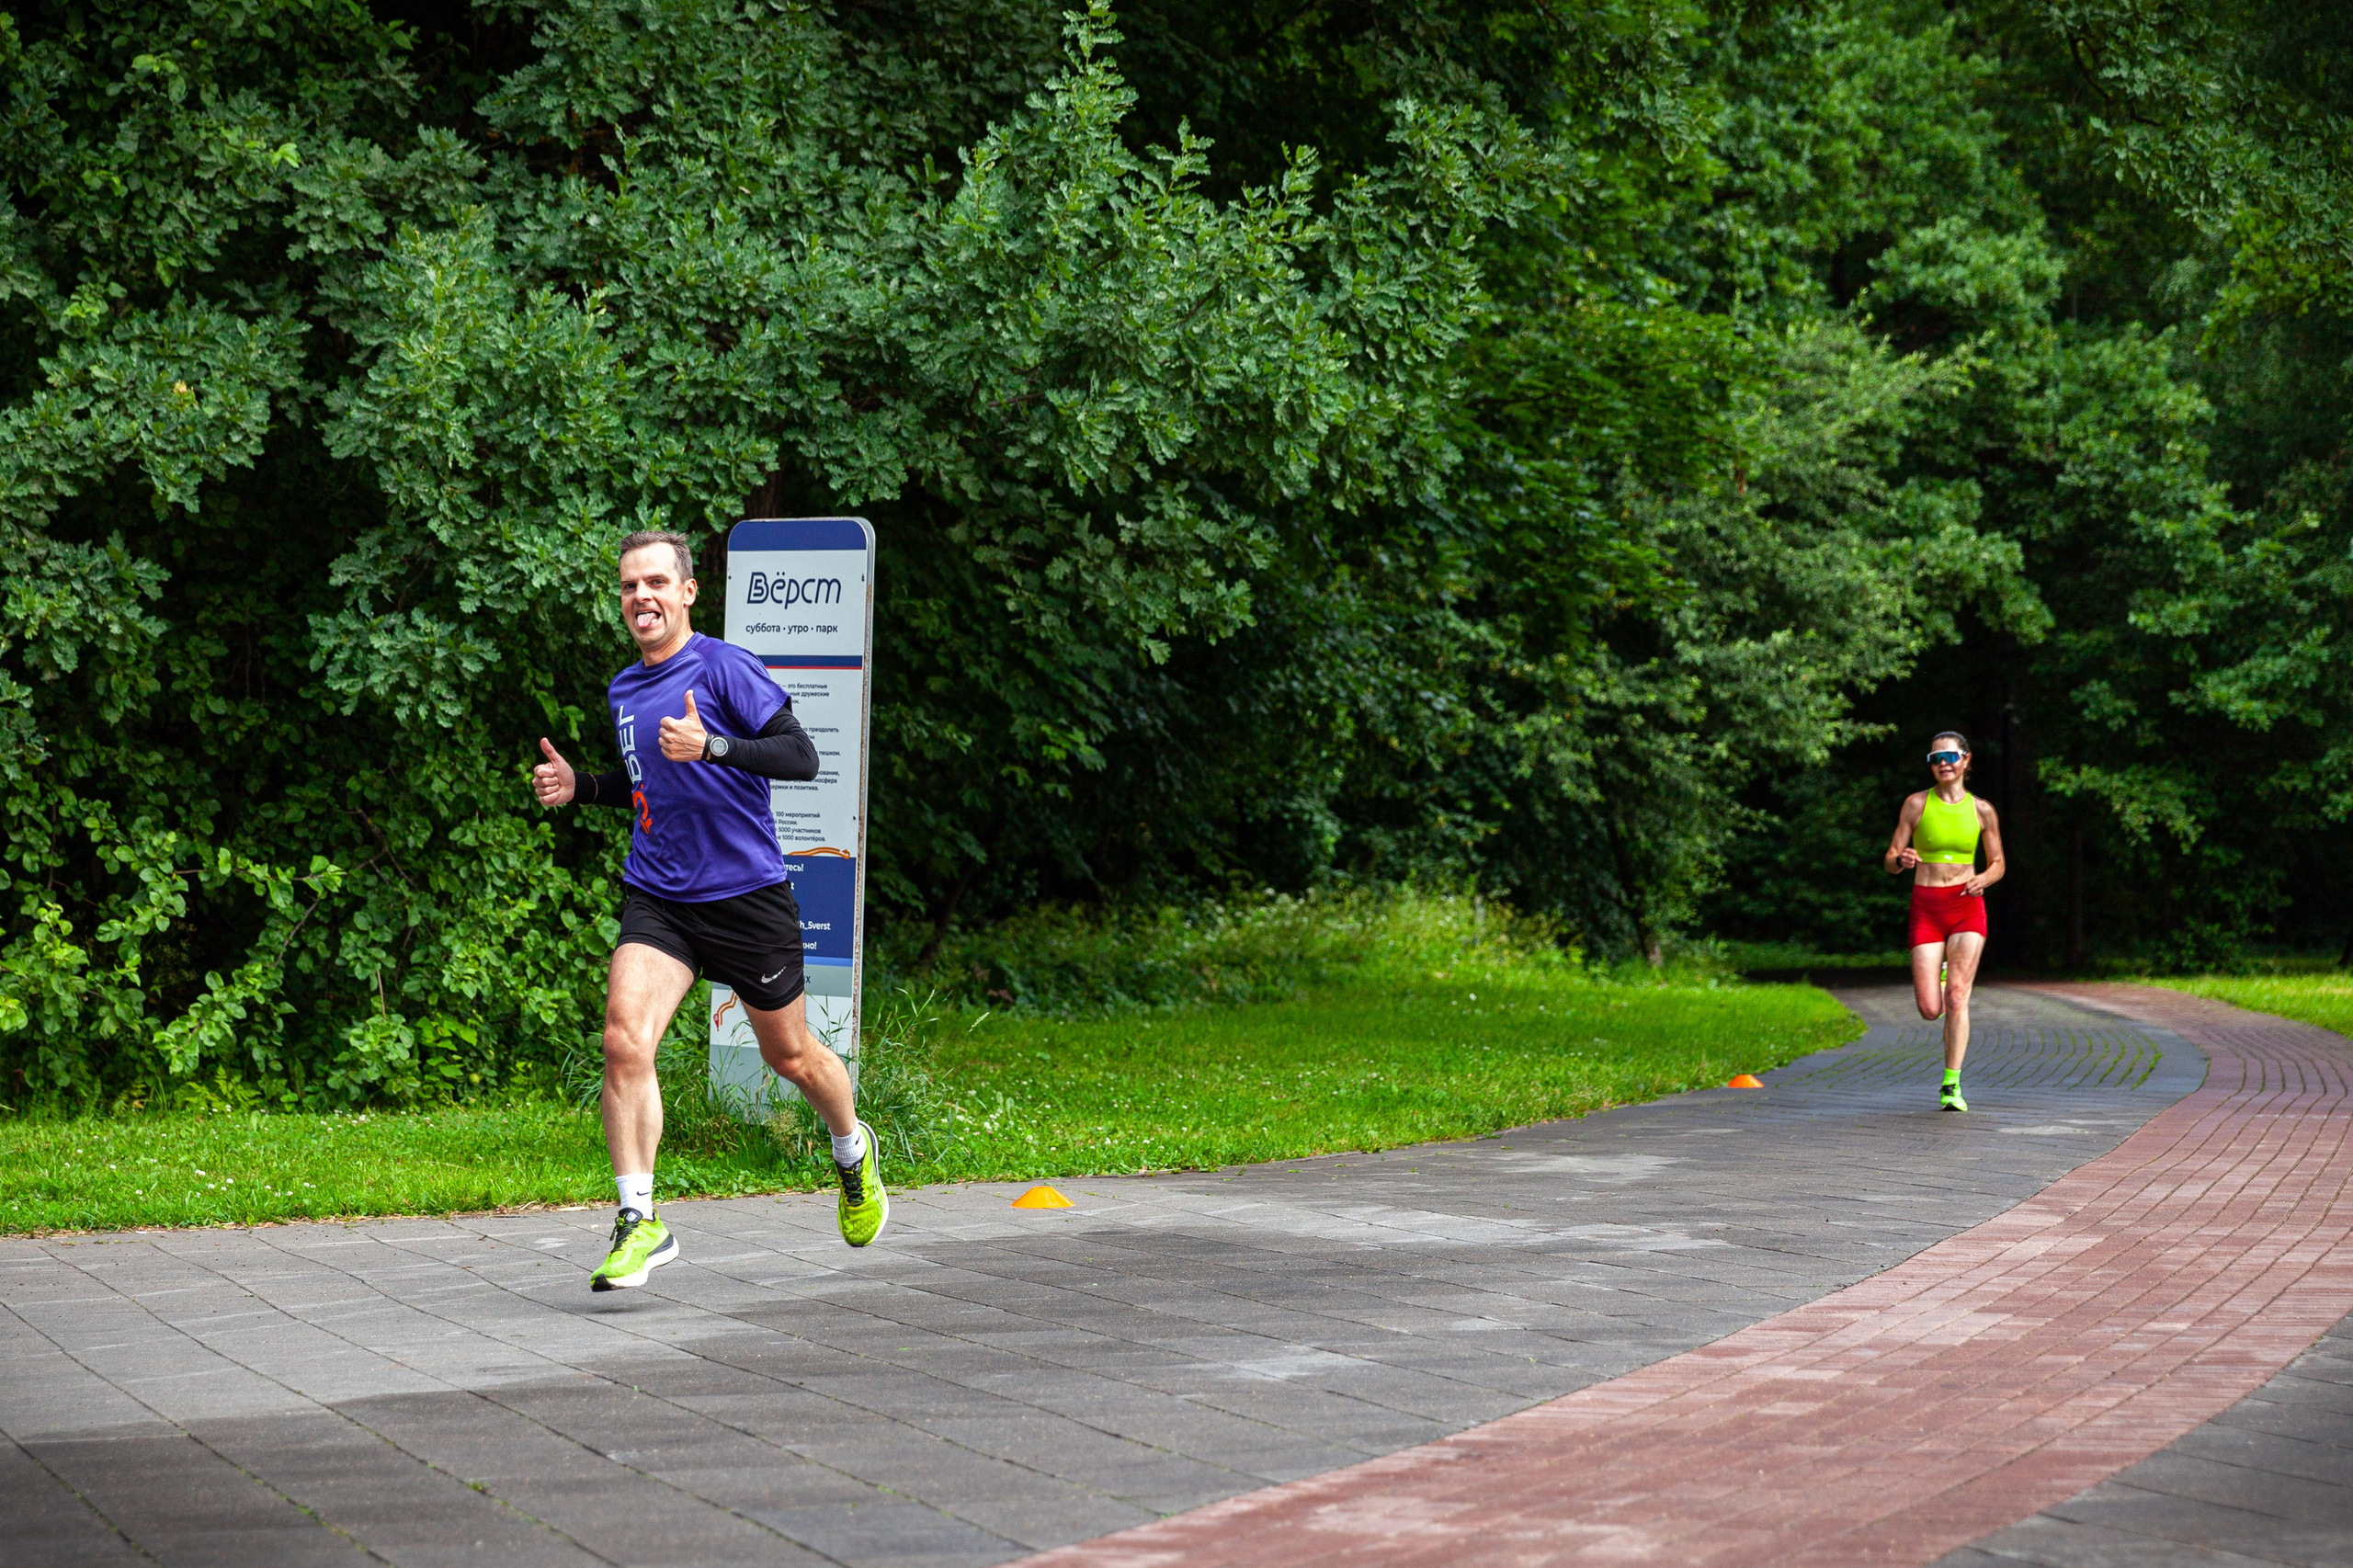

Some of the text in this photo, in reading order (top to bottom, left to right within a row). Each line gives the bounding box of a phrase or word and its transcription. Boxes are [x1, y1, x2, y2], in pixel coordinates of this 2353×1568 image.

[745, 623, 838, 634] суббота утро парк
